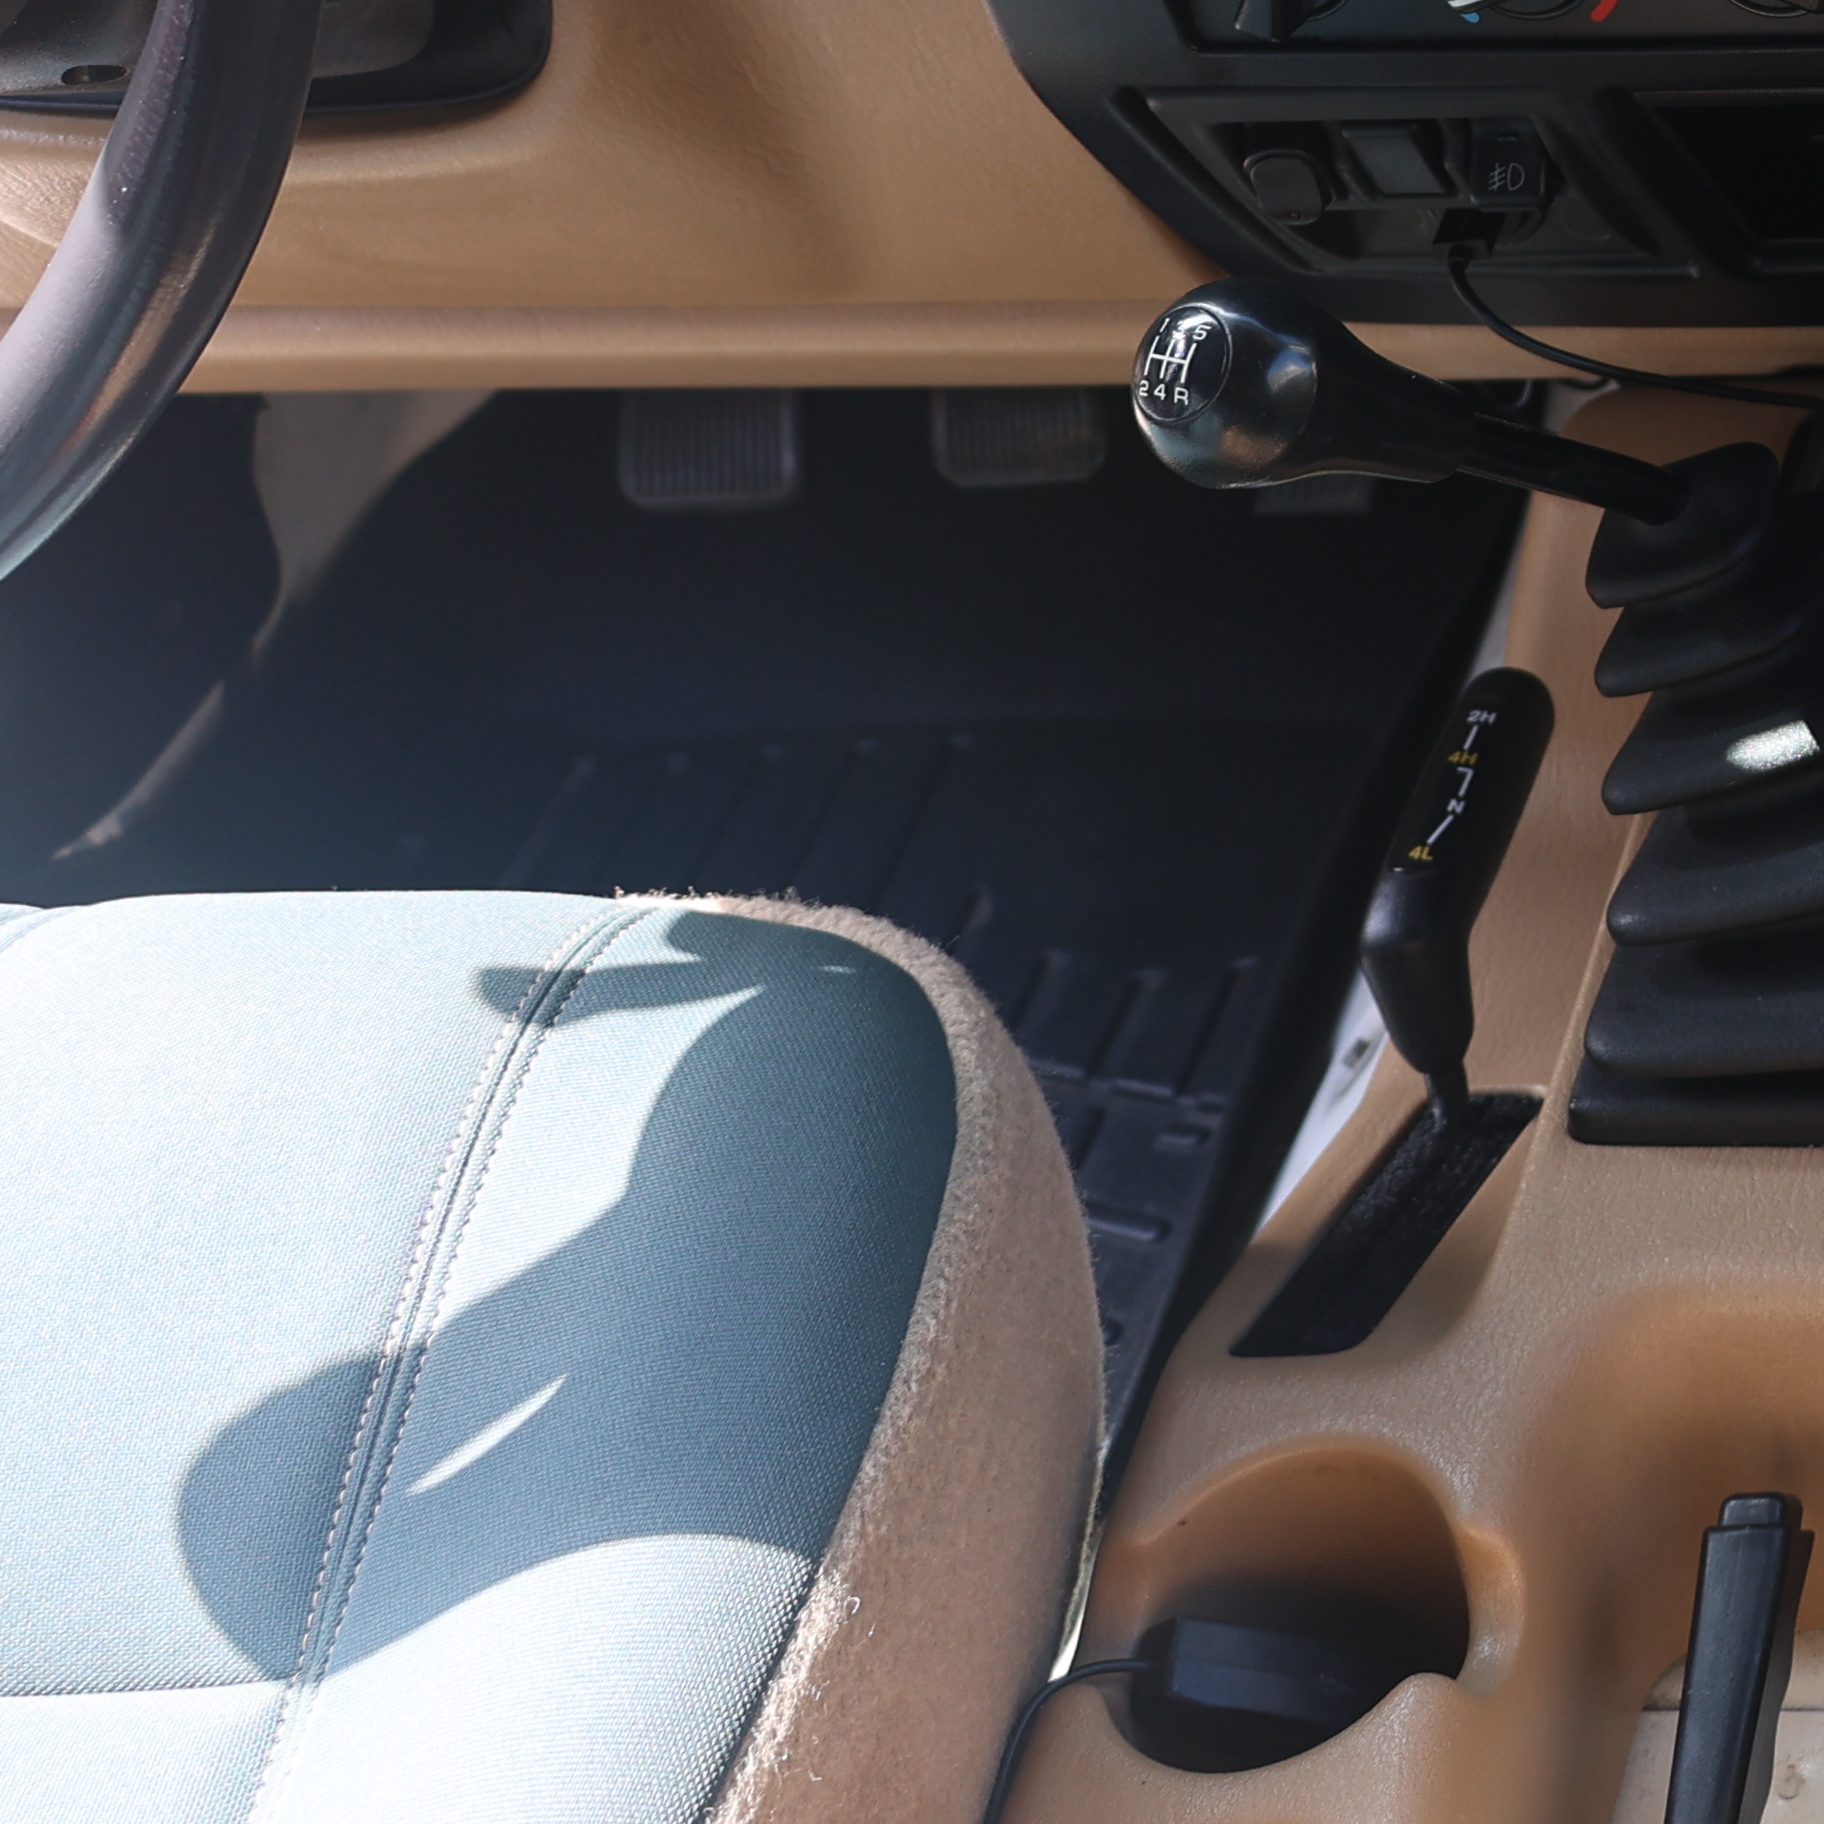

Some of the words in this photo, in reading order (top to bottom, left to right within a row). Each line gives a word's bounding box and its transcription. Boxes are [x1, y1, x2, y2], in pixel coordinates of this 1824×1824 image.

[1160, 317, 1170, 333] 1
[1192, 325, 1212, 341] 5
[1138, 380, 1150, 397] 2
[1153, 383, 1167, 401] 4
[1173, 387, 1189, 406] R
[1467, 709, 1498, 724] 2H
[1447, 750, 1479, 766] 4H
[1446, 798, 1465, 814] N
[1408, 845, 1433, 861] 4L
